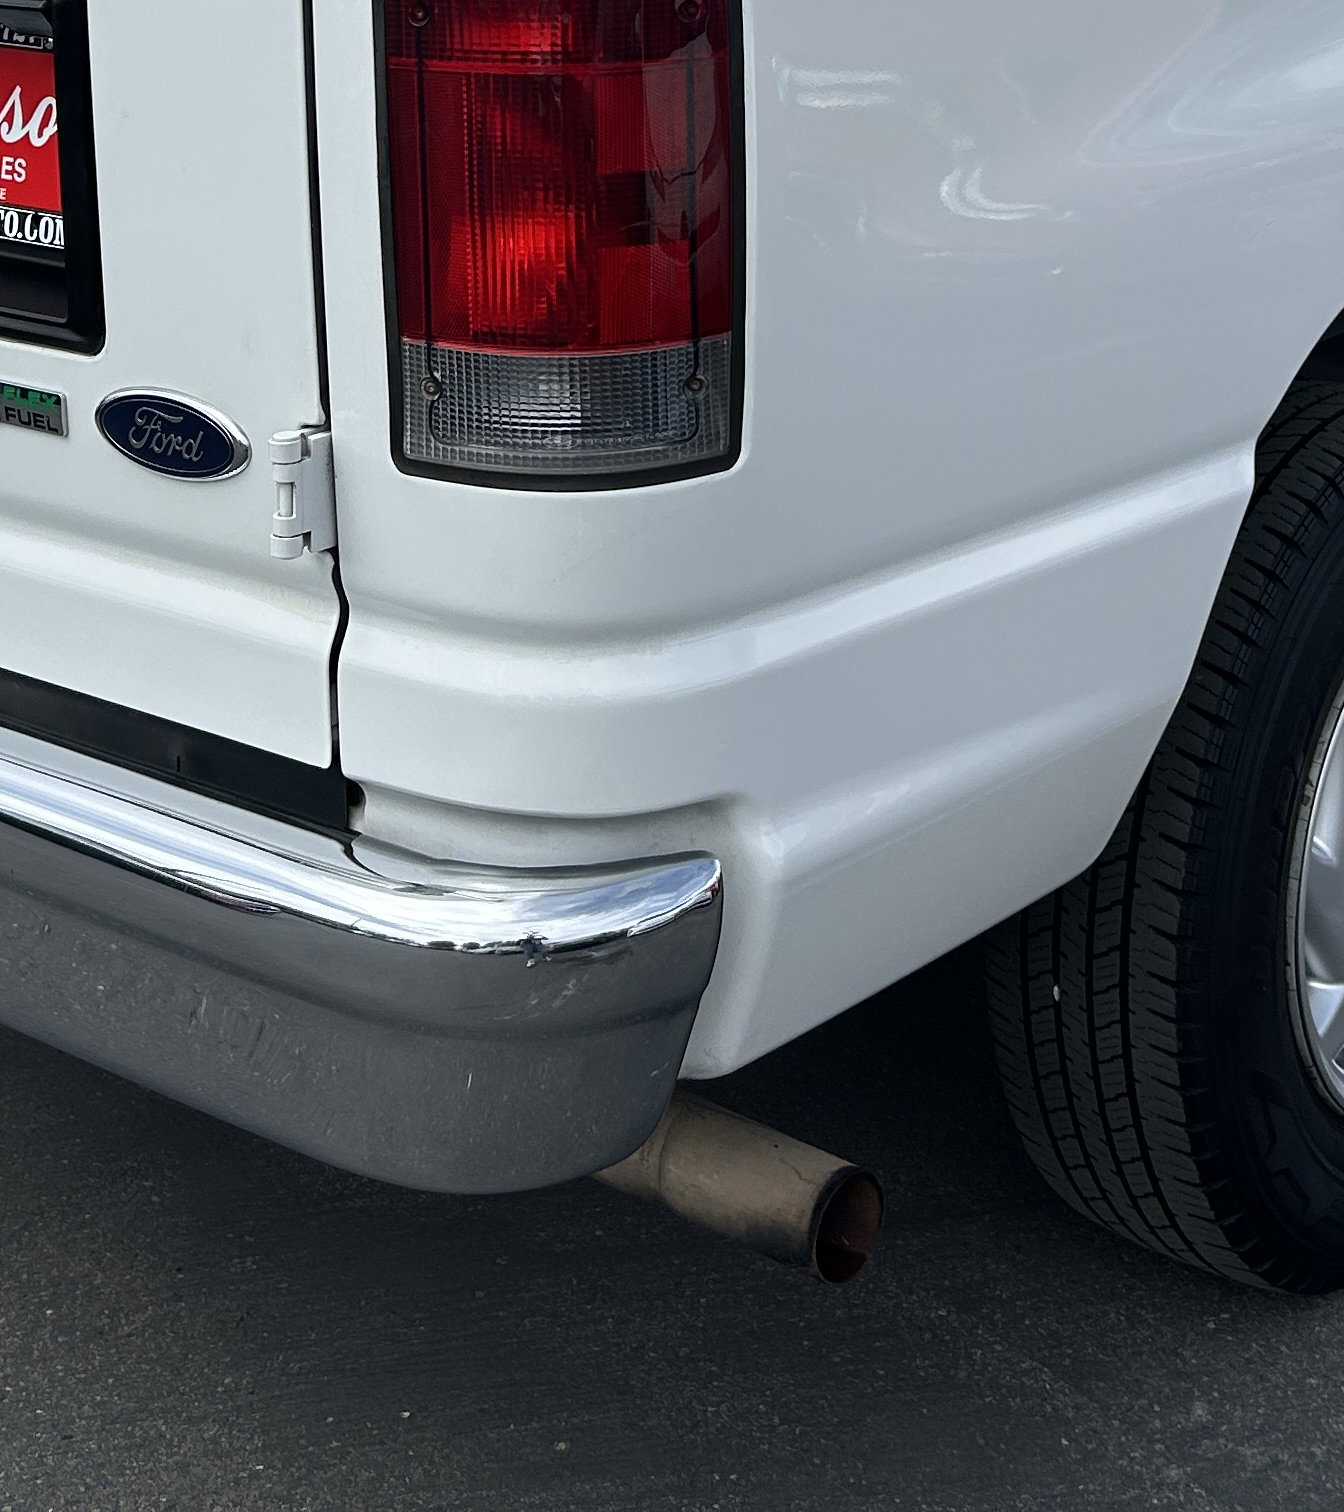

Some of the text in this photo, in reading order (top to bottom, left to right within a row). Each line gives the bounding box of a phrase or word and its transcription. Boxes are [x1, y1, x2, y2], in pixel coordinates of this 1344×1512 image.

[3, 385, 58, 413] FLEX
[4, 405, 59, 434] FUEL
[128, 406, 203, 462] Ford
